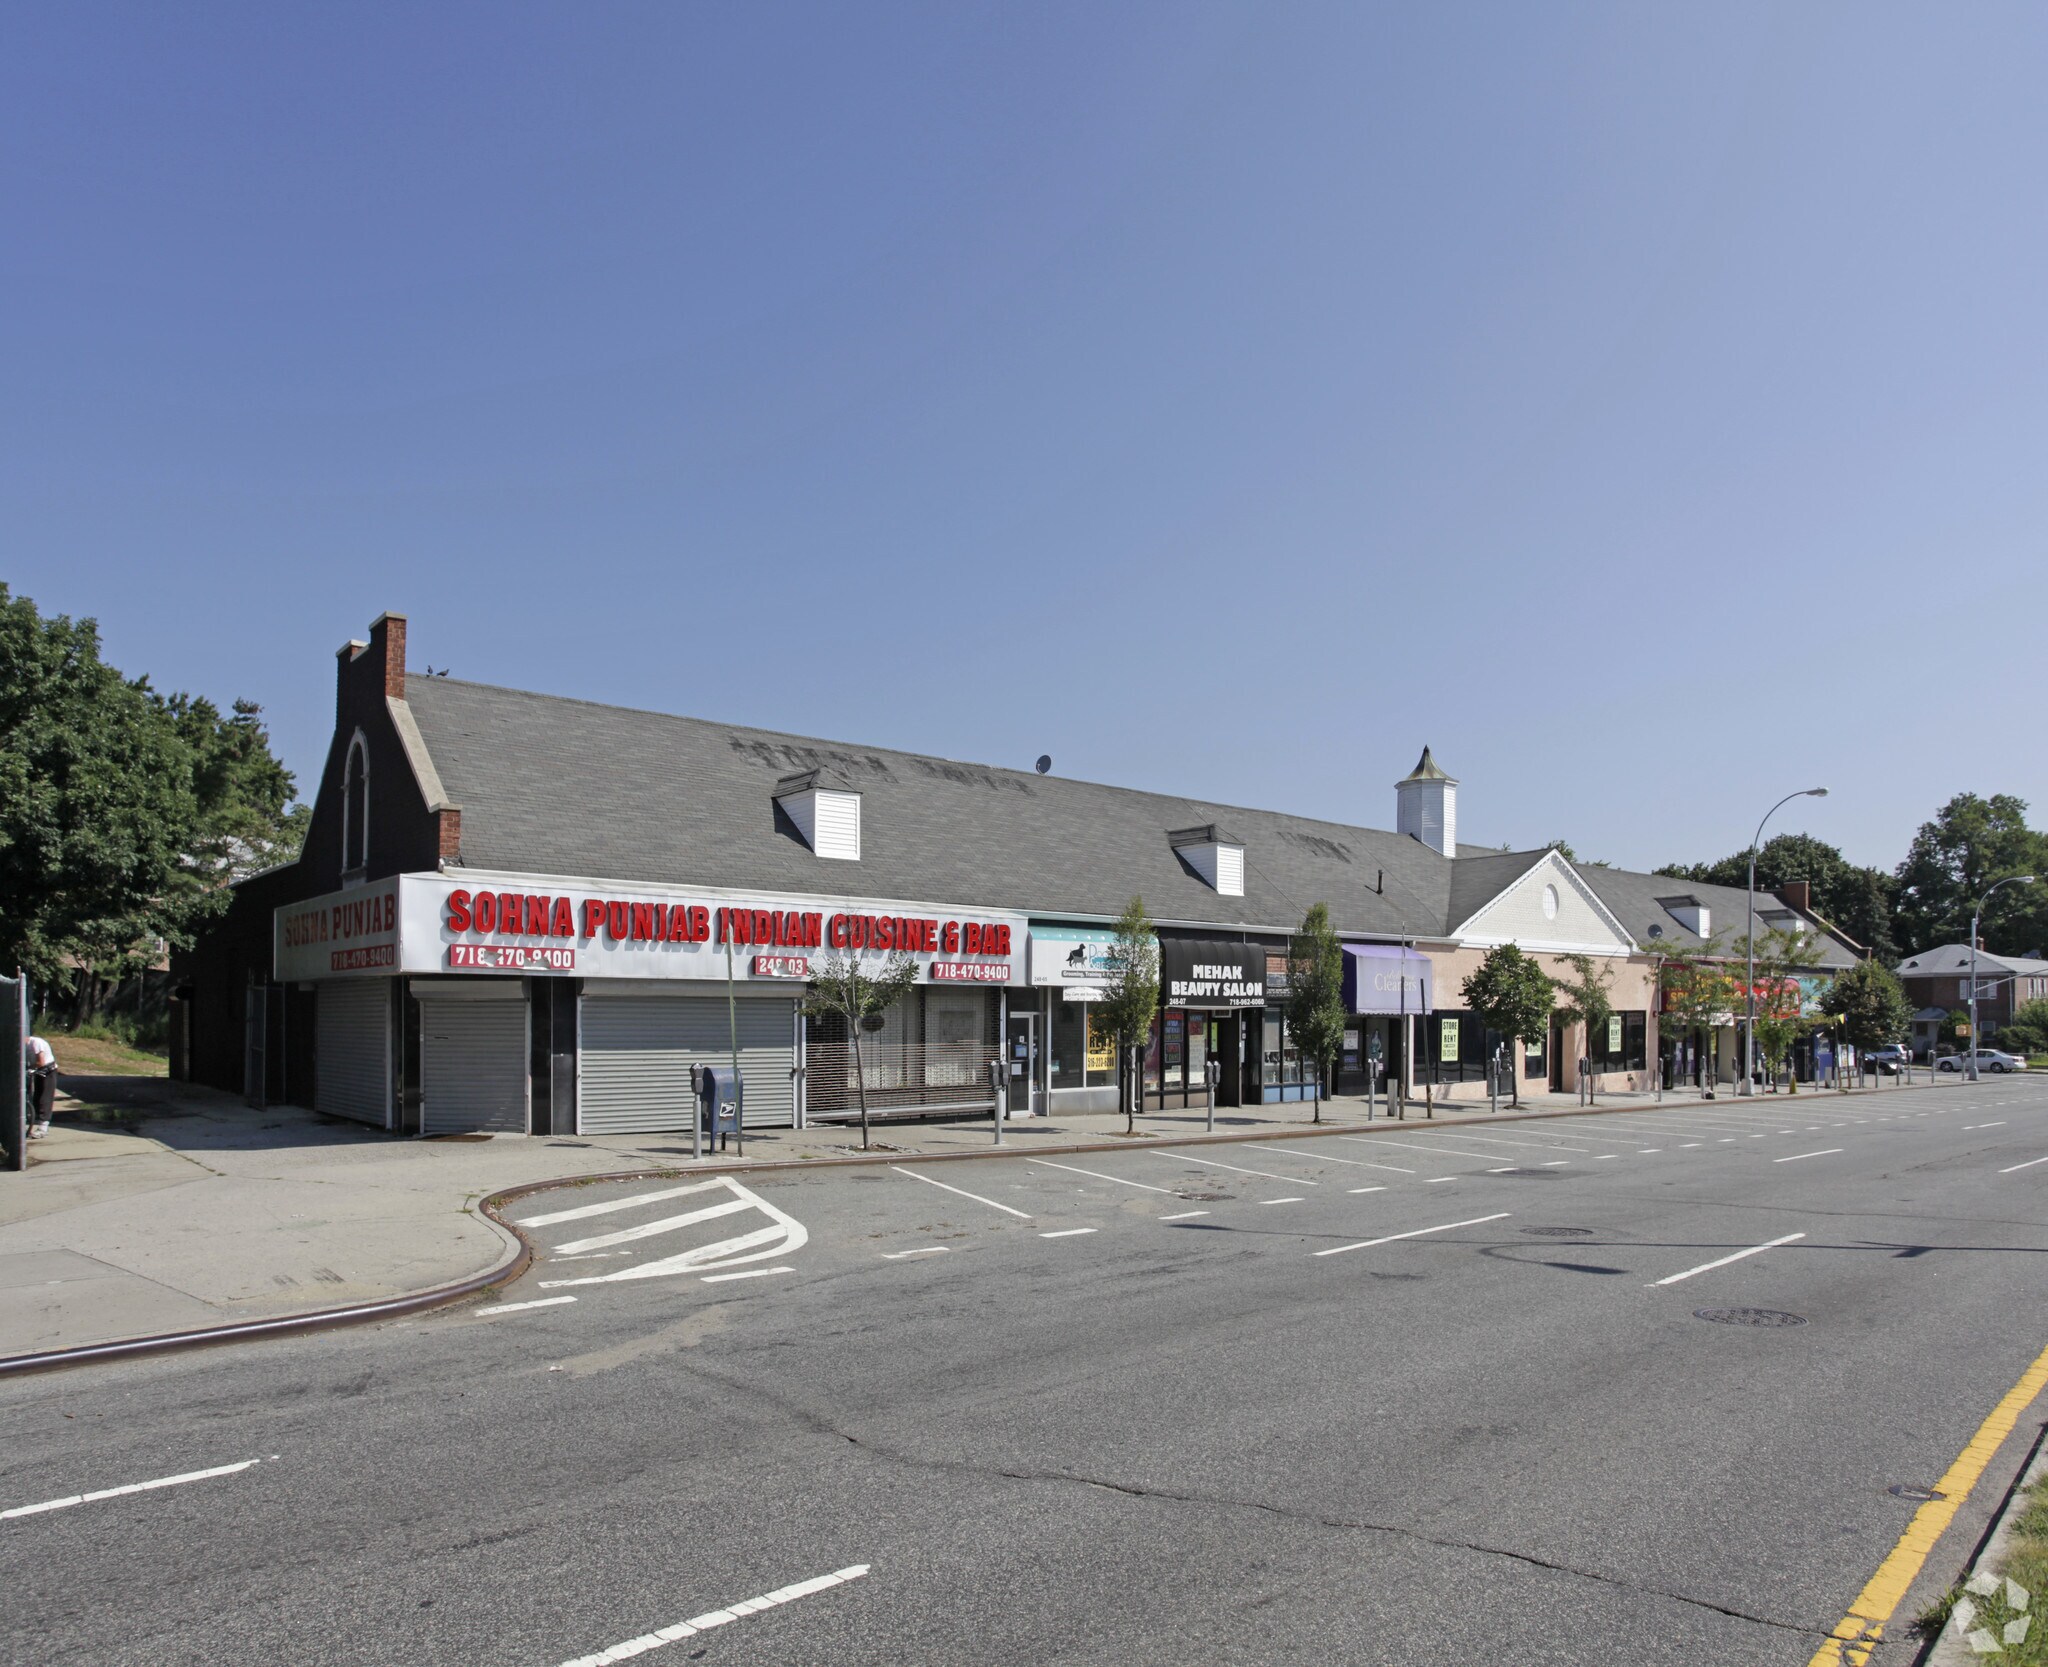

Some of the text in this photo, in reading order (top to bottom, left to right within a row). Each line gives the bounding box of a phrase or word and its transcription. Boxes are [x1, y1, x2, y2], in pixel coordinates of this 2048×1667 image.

[285, 894, 395, 947] SOHNA PUNJAB
[448, 889, 1011, 955] SOHNA PUNJAB INDIAN CUISINE & BAR
[333, 946, 393, 969] 718-470-9400
[937, 963, 1009, 980] 718-470-9400
[1192, 964, 1243, 980] MEHAK
[1171, 981, 1221, 996] BEAUTY
[1222, 982, 1263, 996] SALON
[1443, 1021, 1458, 1030] STORE
[1443, 1034, 1457, 1043] RENT
